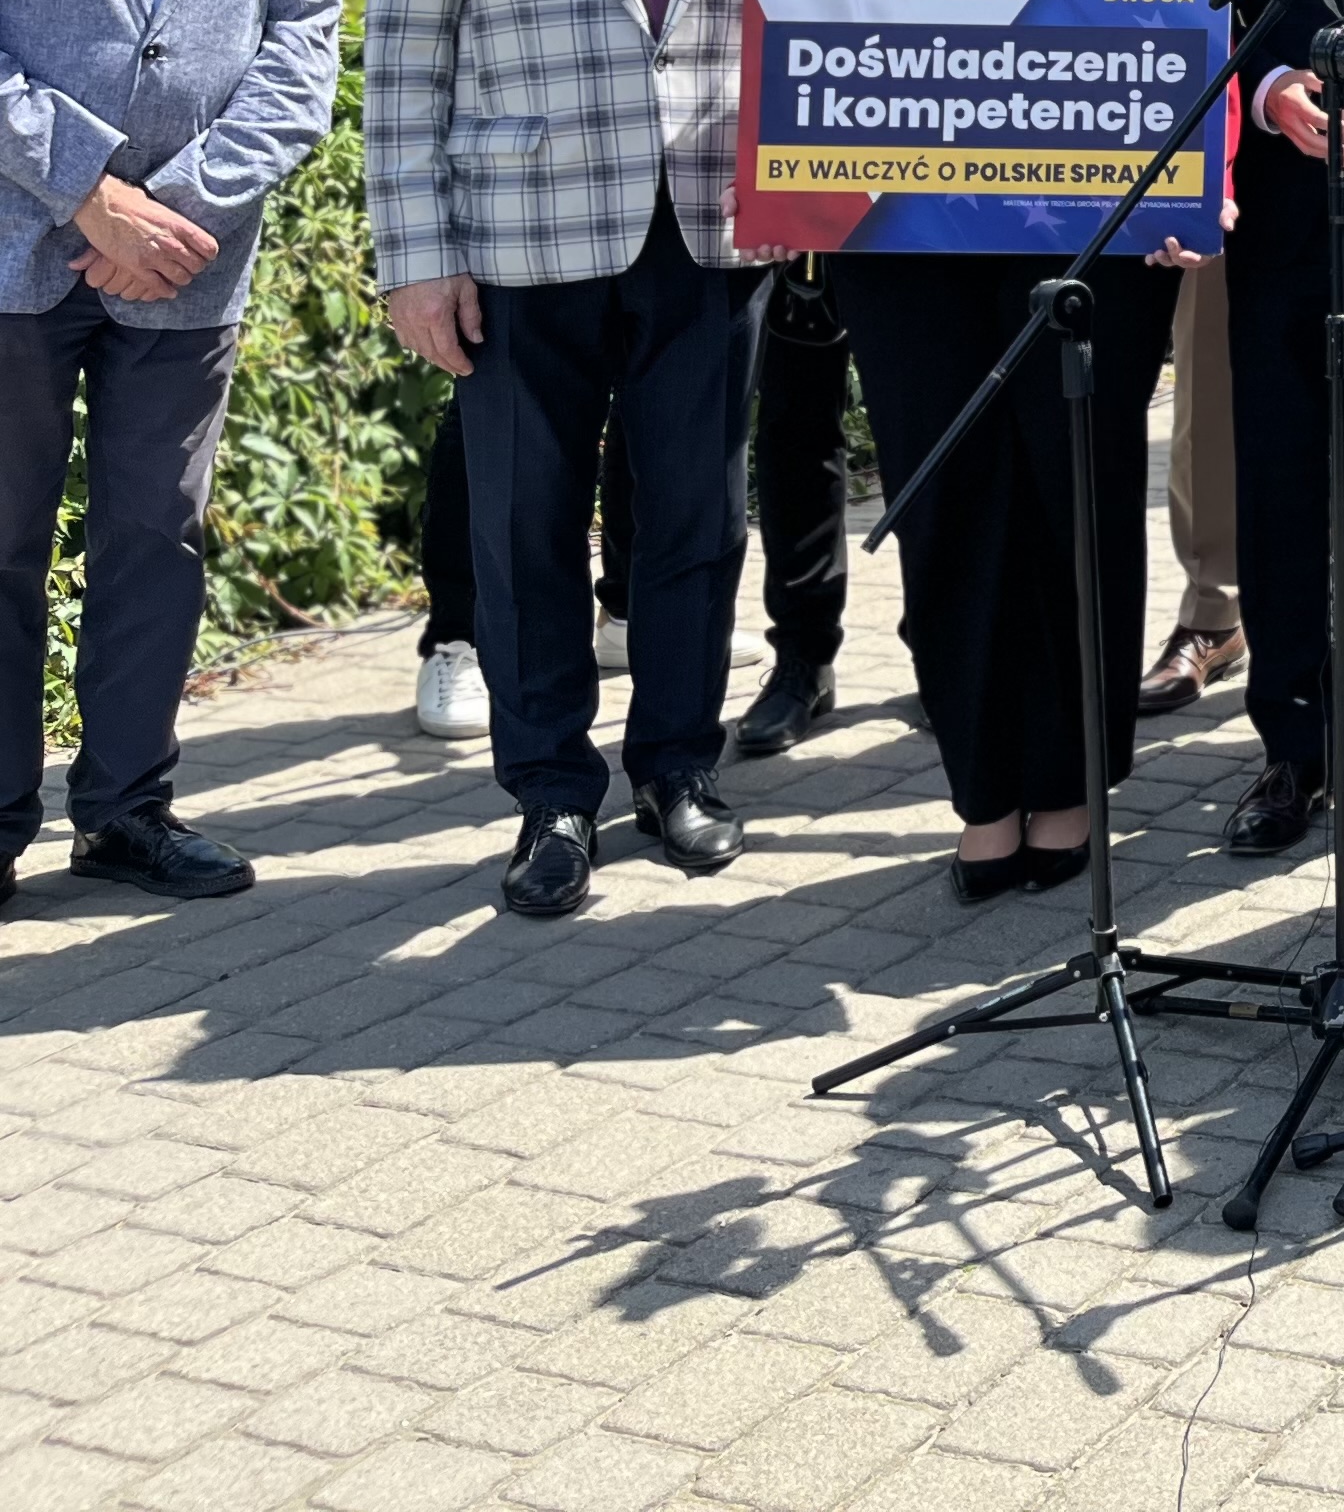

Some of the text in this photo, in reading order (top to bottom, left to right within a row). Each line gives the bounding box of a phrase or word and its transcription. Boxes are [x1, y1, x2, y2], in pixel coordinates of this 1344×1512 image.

[788, 34, 1187, 82] Doświadczenie
[797, 84, 1174, 144] i kompetencje
[769, 159, 800, 179] BY
[808, 155, 930, 181] WALCZYĆ
[938, 162, 956, 181] O
[964, 163, 1065, 183] POLSKIE
